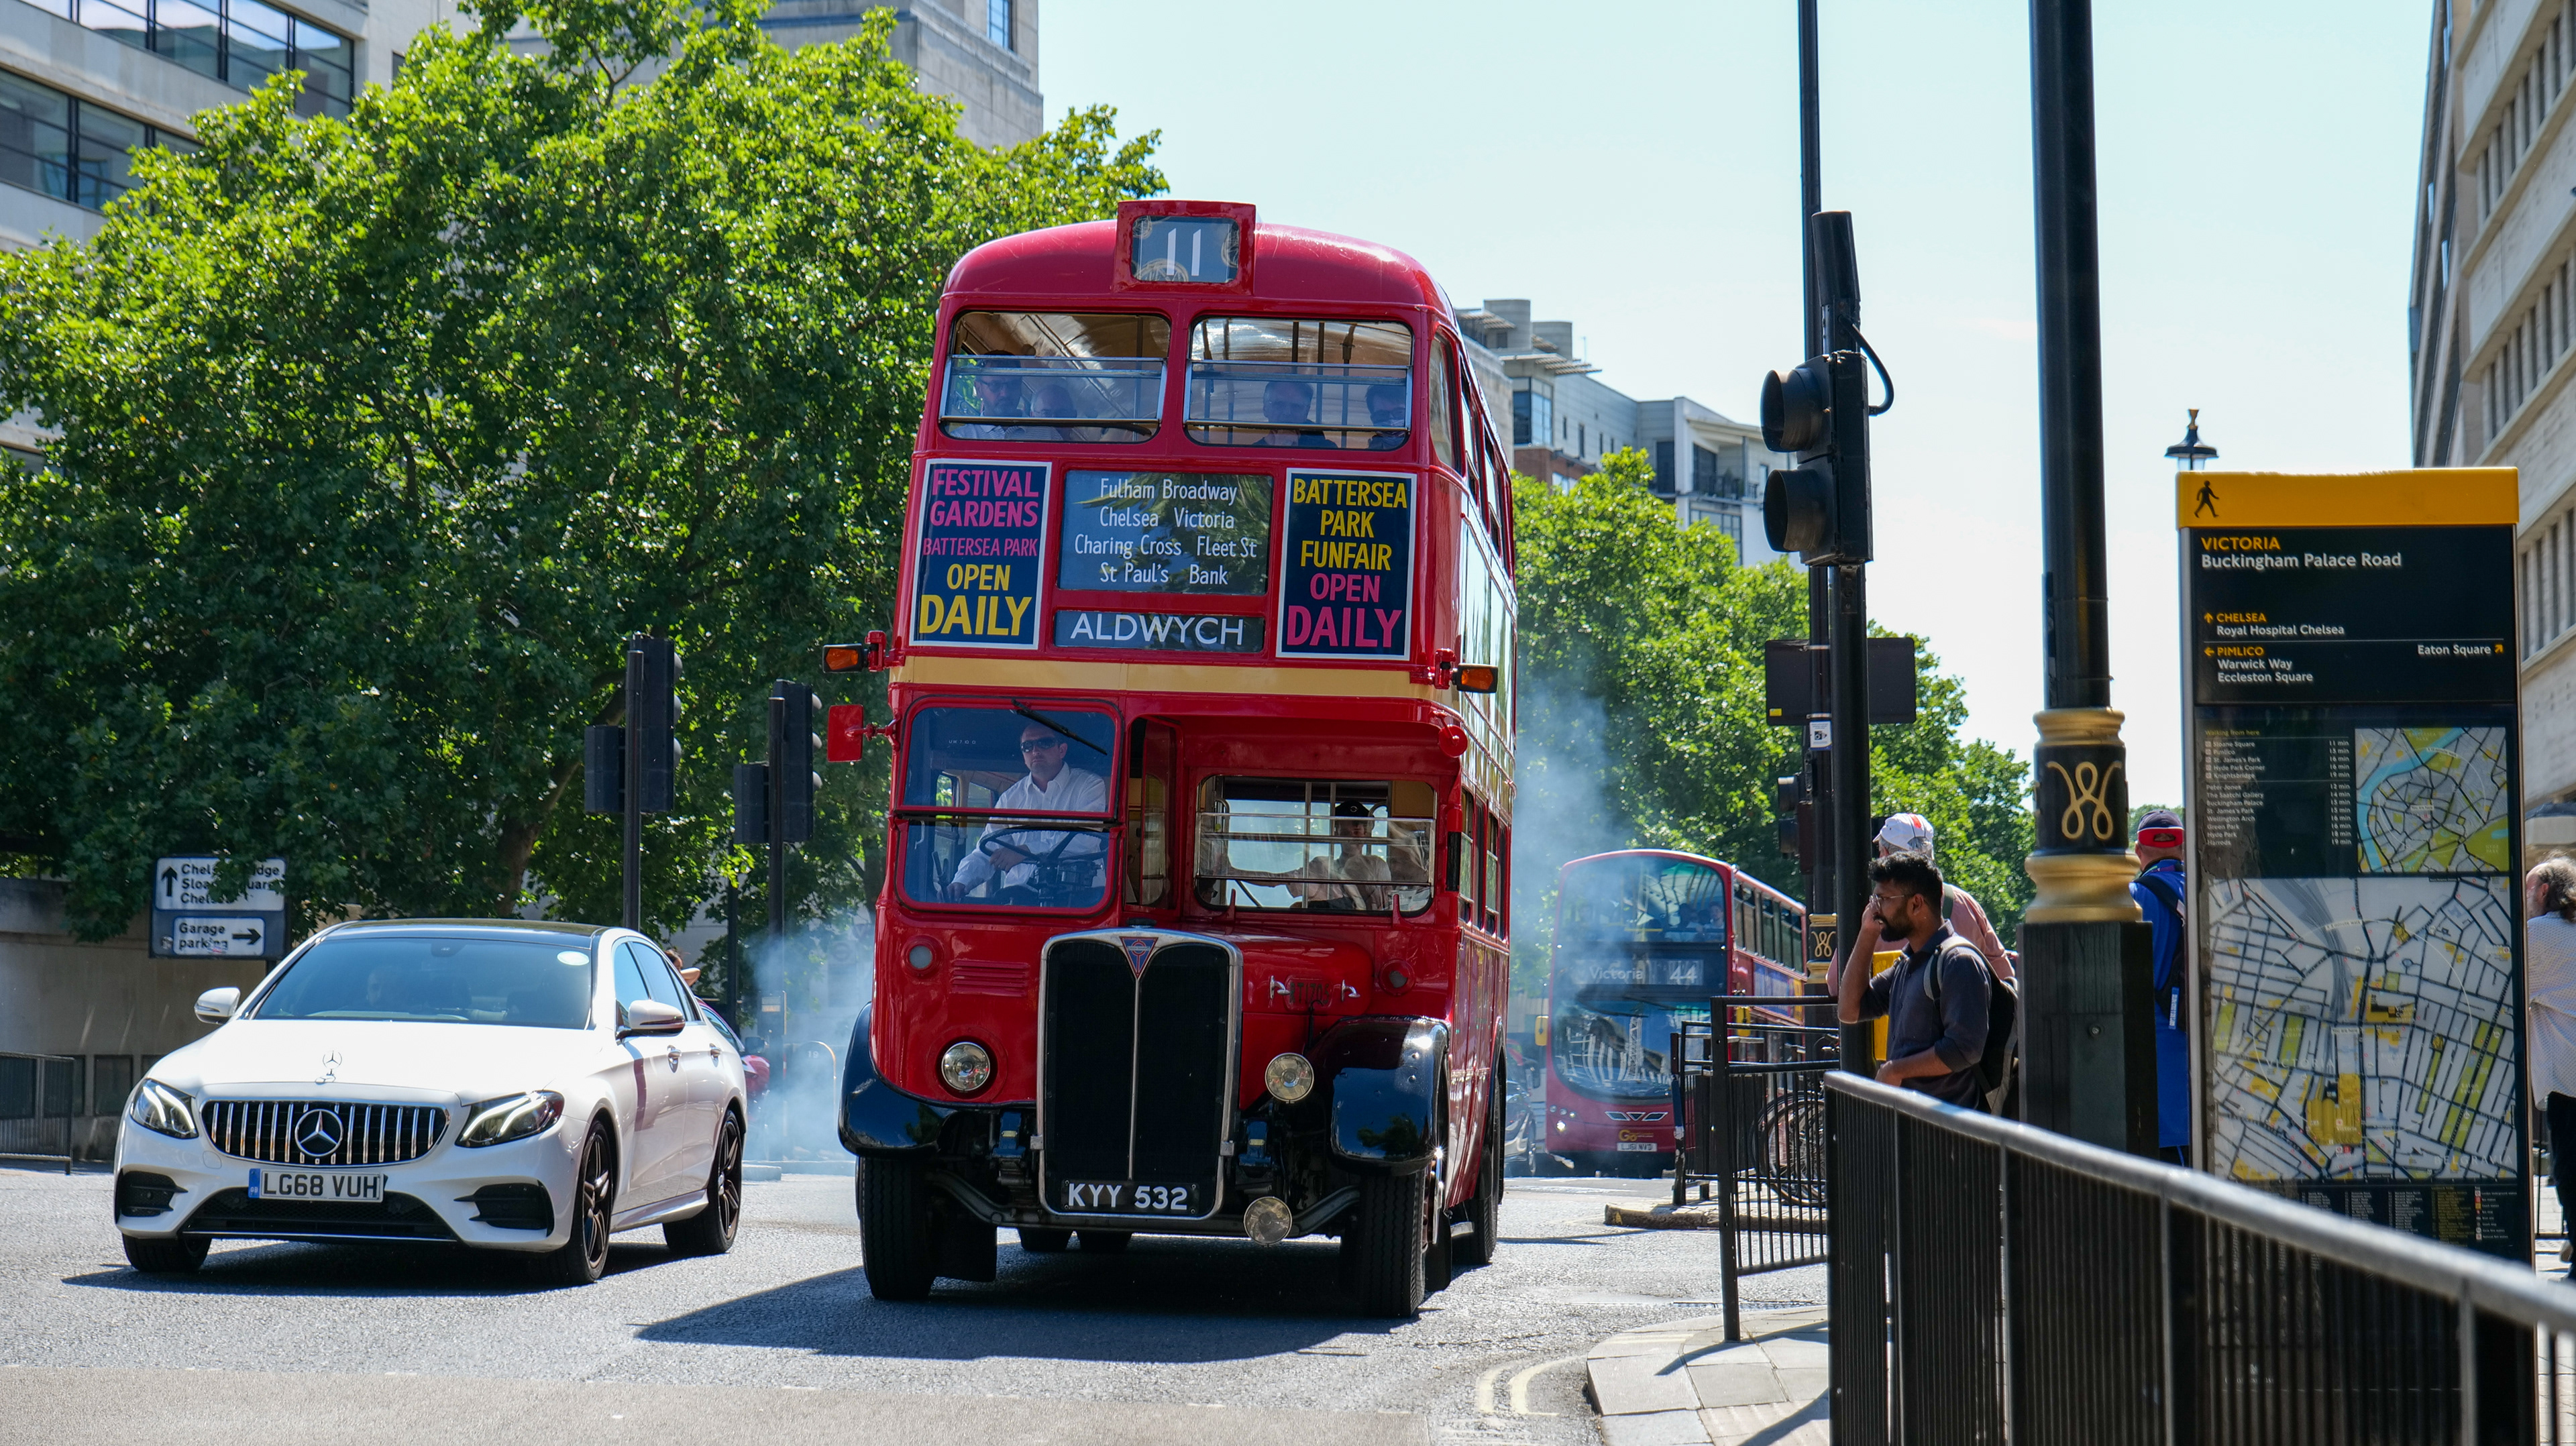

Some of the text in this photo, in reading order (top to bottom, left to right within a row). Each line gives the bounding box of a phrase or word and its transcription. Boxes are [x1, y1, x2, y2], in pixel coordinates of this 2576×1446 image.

[1167, 228, 1201, 276] 11
[931, 469, 1038, 498] FESTIVAL
[1100, 478, 1237, 504] Fulham Broadway
[1293, 478, 1407, 509] BATTERSEA
[930, 502, 1038, 528] GARDENS
[1099, 506, 1234, 529] Chelsea Victoria
[1320, 510, 1375, 537] PARK
[923, 537, 1036, 557] BATTERSEA PARK
[1075, 534, 1257, 559] Charing Cross Fleet St
[1301, 540, 1392, 571] FUNFAIR
[2201, 537, 2281, 550] VICTORIA
[1100, 562, 1228, 586] St Paul's Bank
[2202, 553, 2402, 571] Buckingham Palace Road
[947, 564, 1010, 592] OPEN
[1310, 573, 1380, 602] OPEN
[919, 594, 1032, 636] DAILY
[1287, 605, 1402, 648] DAILY
[2216, 612, 2266, 623] CHELSEA
[1071, 615, 1243, 646] ALDWYCH
[2216, 624, 2345, 637] Royal Hospital Chelsea
[2217, 647, 2264, 657] PIMLICO
[2417, 644, 2491, 657] Eaton Square
[2217, 658, 2292, 671] Warwick Way
[2218, 671, 2313, 684] Eccleston Square
[179, 922, 225, 936] Garage
[1589, 964, 1697, 984] Victoria 44
[2265, 1058, 2335, 1069] VICTORIA
[2434, 1155, 2513, 1165] BELGRAVIA
[264, 1173, 378, 1198] LG68 VUH
[1069, 1183, 1187, 1210] KYY 532
